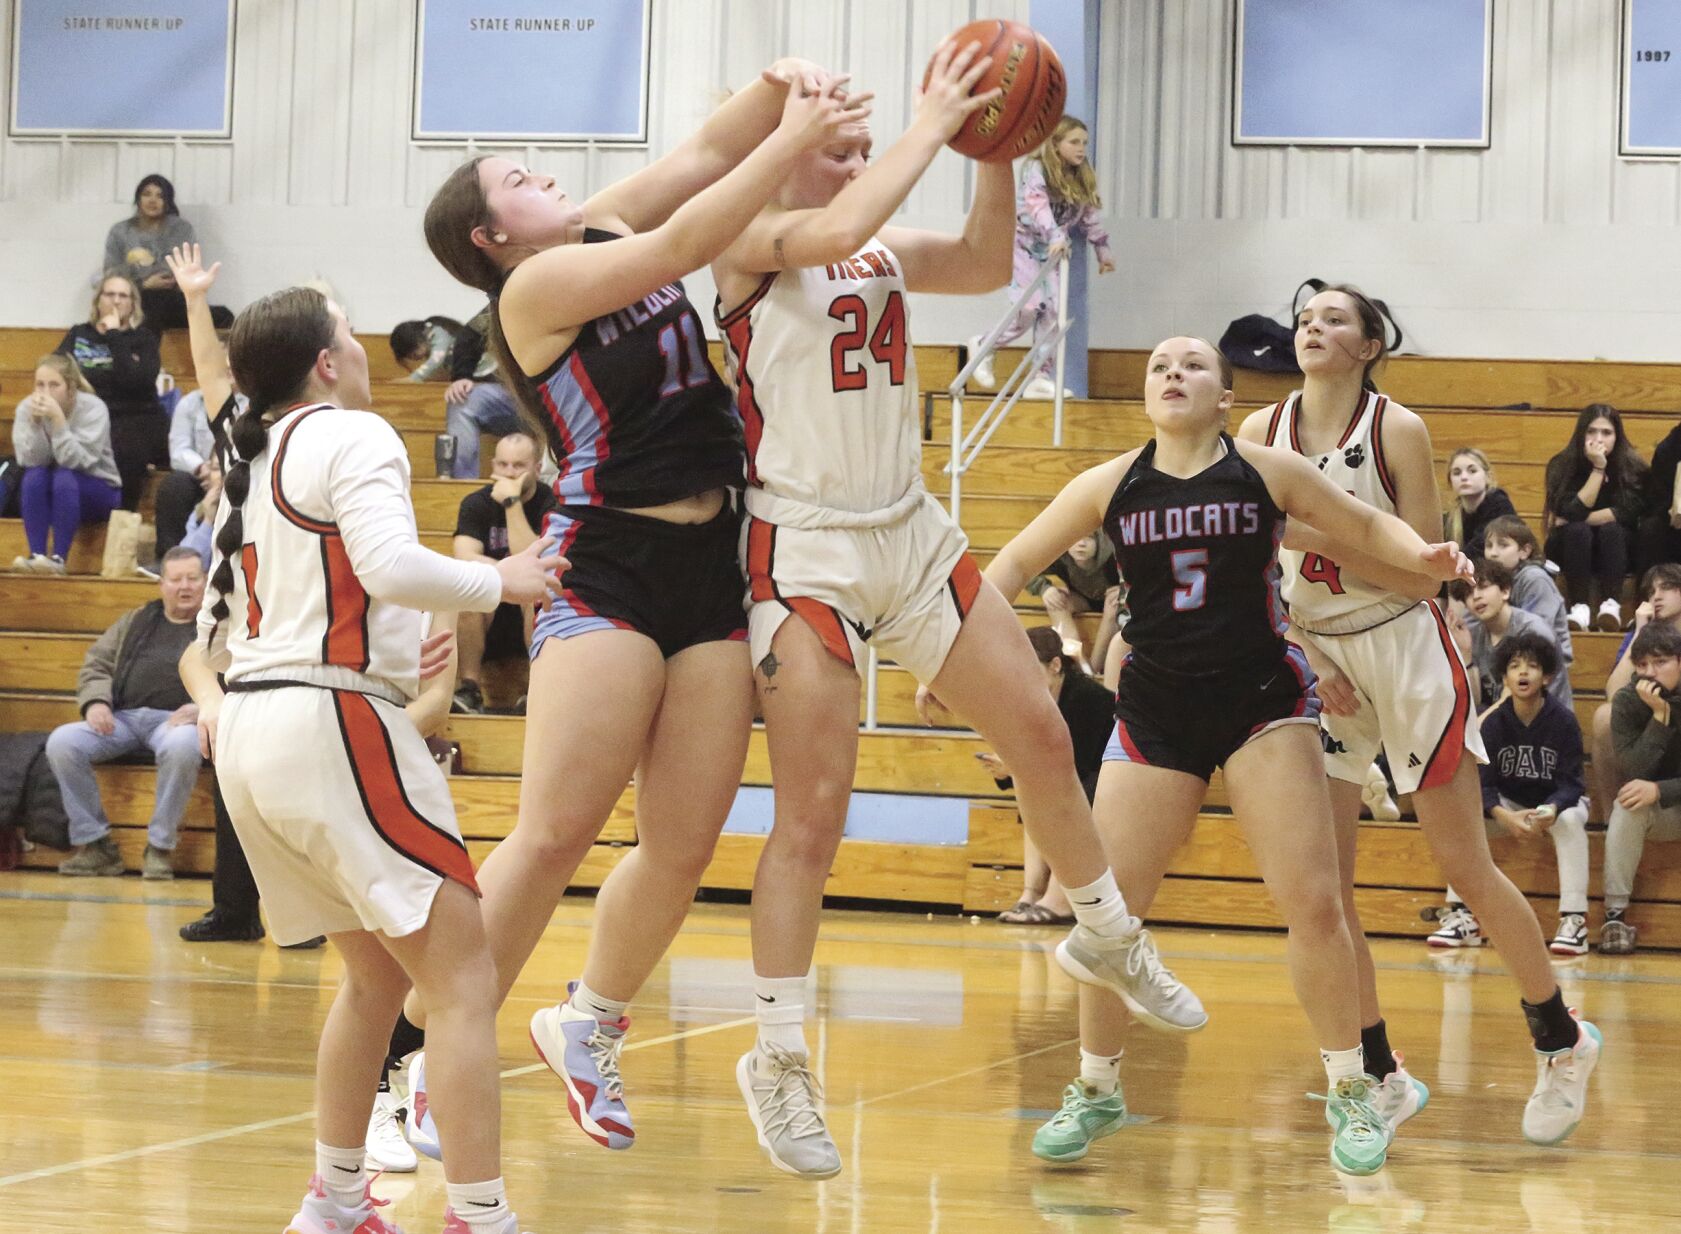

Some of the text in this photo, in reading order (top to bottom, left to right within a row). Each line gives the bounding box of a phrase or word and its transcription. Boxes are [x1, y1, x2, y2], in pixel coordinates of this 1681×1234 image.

[63, 17, 101, 31] STATE
[470, 18, 509, 31] STATE
[657, 310, 710, 398] 11
[827, 290, 907, 394] 24
[1118, 502, 1260, 547] WILDCATS
[1170, 548, 1210, 612] 5
[1497, 745, 1558, 780] GAP
